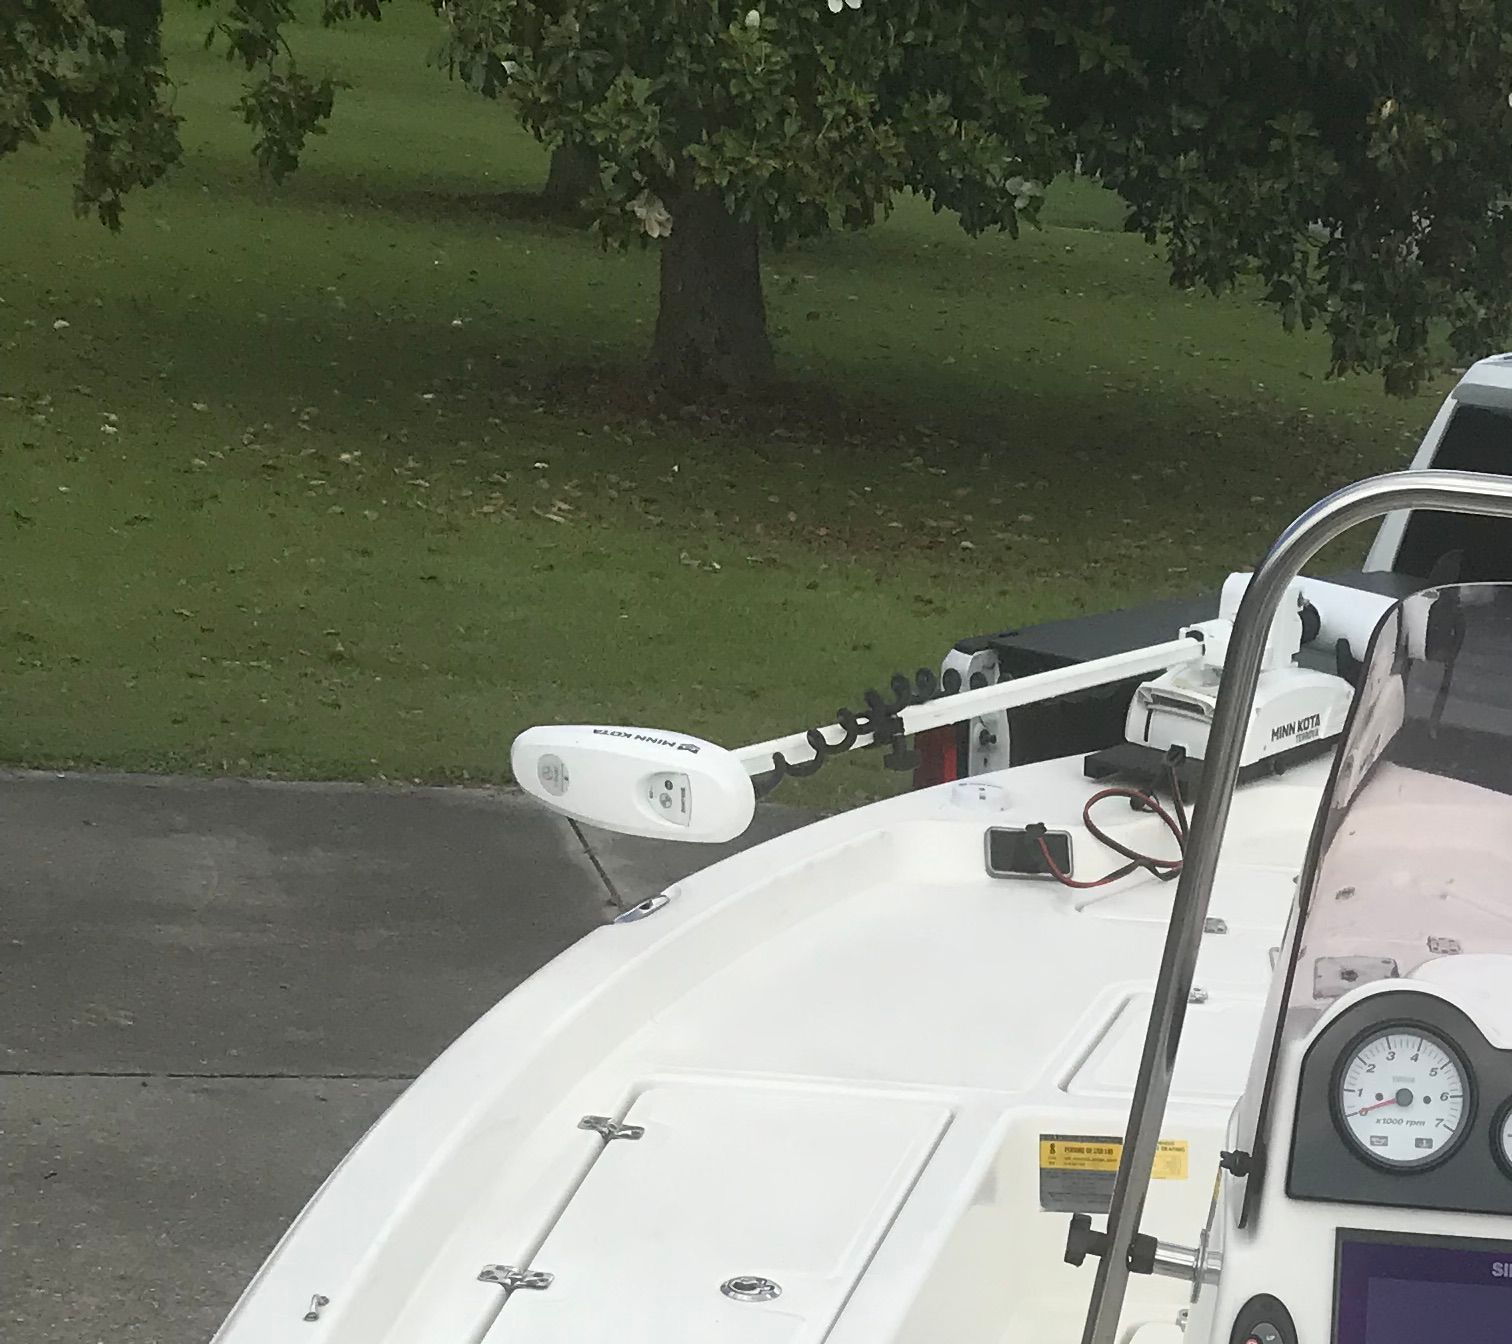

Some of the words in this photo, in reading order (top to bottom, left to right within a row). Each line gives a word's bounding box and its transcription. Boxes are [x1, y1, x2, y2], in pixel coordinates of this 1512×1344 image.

[1271, 721, 1297, 742] MINN
[1297, 713, 1320, 732] KOTA
[633, 734, 677, 748] MINN
[1386, 1052, 1396, 1061] 3
[1410, 1053, 1419, 1062] 4
[1366, 1064, 1376, 1073] 2
[1429, 1068, 1438, 1077] 5
[1355, 1088, 1363, 1097] 1
[1440, 1092, 1449, 1101] 6
[1375, 1118, 1404, 1126] x1000
[1405, 1119, 1426, 1127] rpm
[1435, 1118, 1444, 1128] 7
